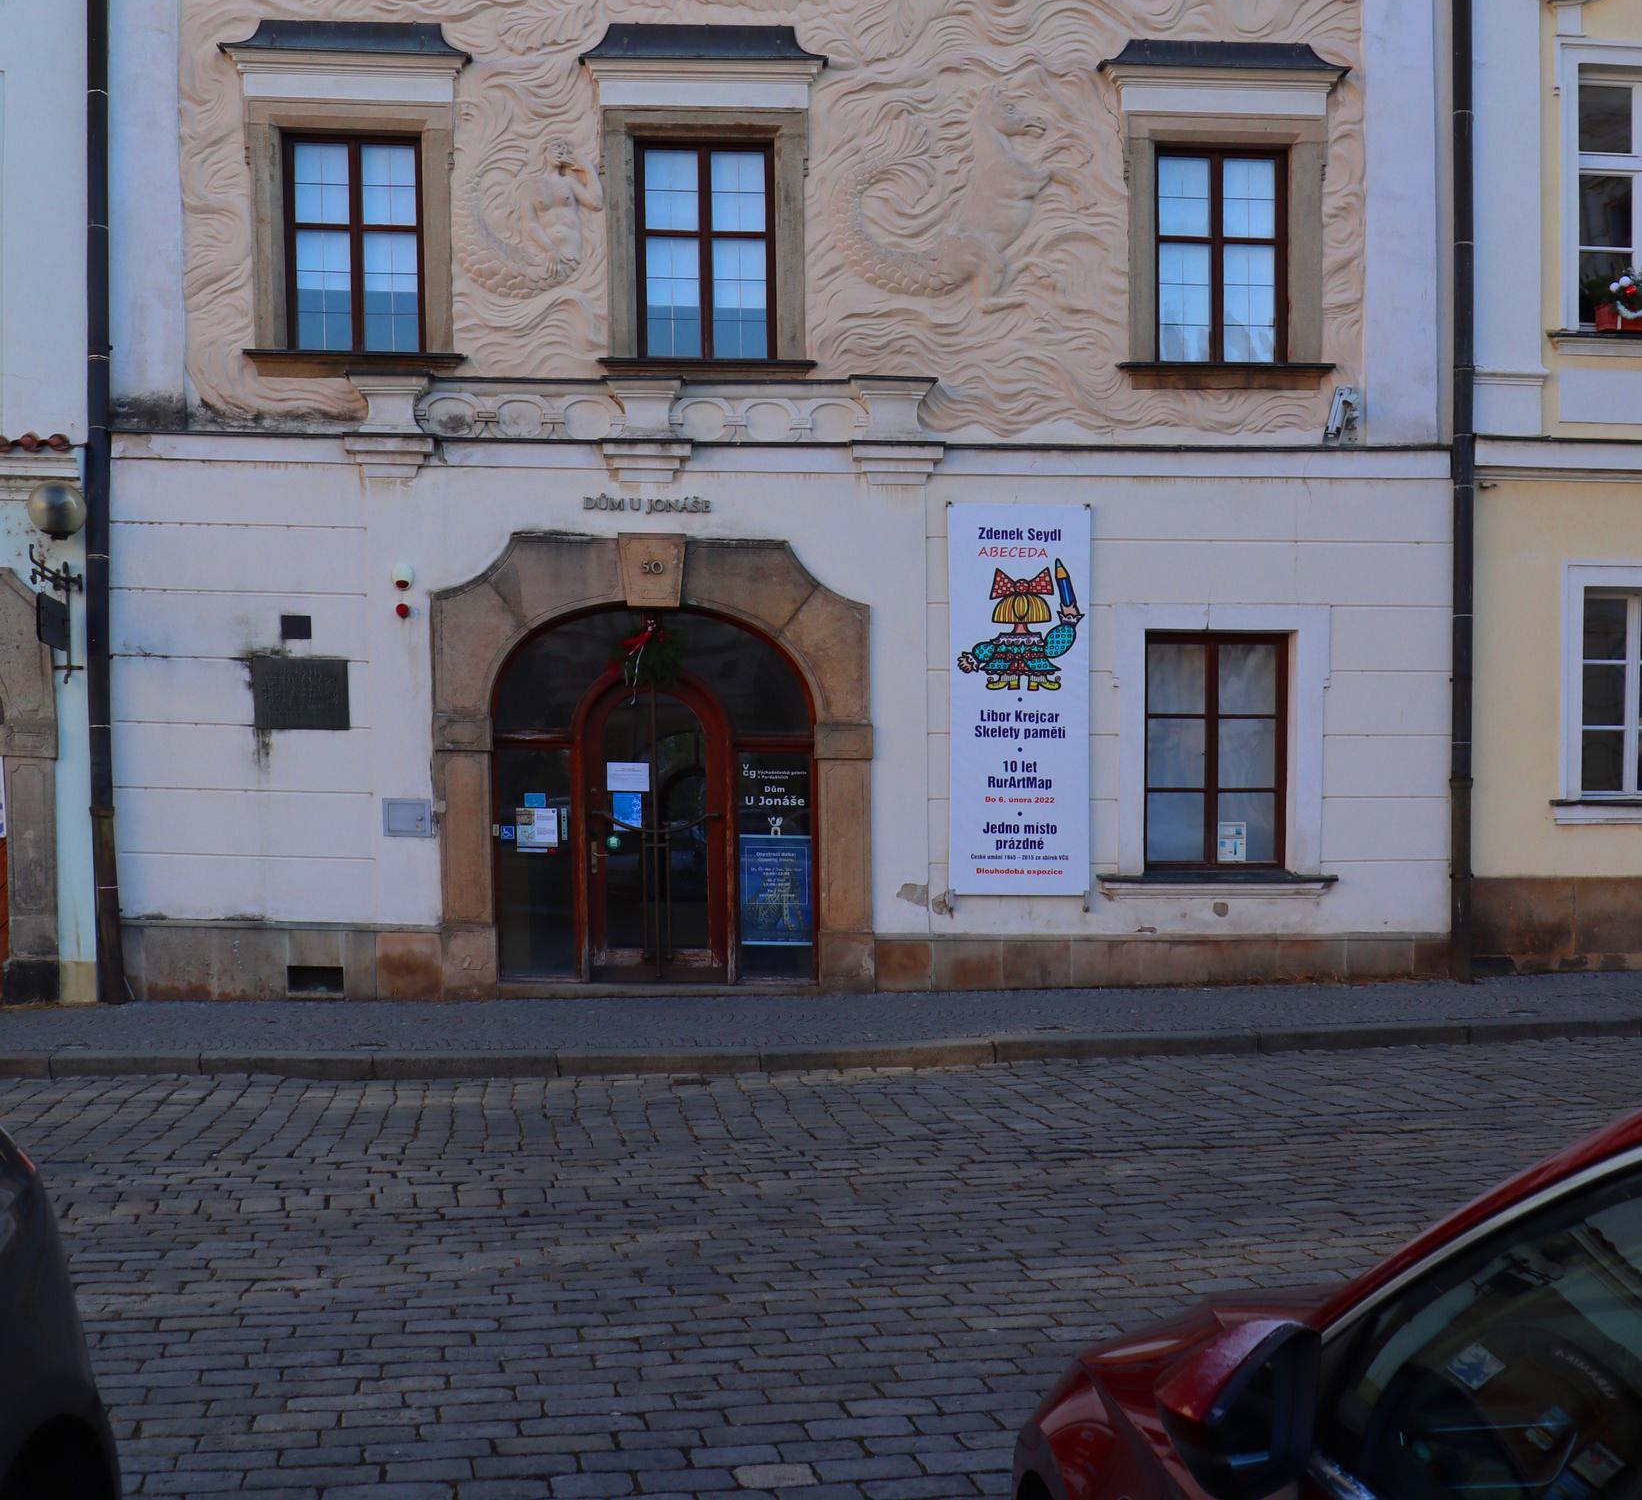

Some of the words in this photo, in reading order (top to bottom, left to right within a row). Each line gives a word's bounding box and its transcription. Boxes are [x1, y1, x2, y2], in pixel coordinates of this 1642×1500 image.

[583, 493, 625, 511] DŮM
[629, 498, 642, 511] U
[645, 496, 712, 515] JONÁŠE
[978, 527, 1024, 540] Zdenek
[1027, 528, 1062, 542] Seydl
[978, 546, 1049, 558] ABECEDA
[641, 561, 664, 575] 50
[980, 709, 1012, 722] Libor
[1015, 710, 1060, 724] Krejcar
[974, 725, 1020, 740] Skelety
[1024, 726, 1066, 740] paměti
[1003, 760, 1018, 773] 10
[1021, 760, 1038, 773] let
[764, 785, 785, 793] Dům
[987, 776, 1053, 790] RurArtMap
[745, 795, 755, 806] U
[758, 795, 806, 806] Jonáše
[1008, 795, 1032, 803] února
[982, 821, 1020, 834] Jedno
[1023, 821, 1058, 835] místo
[995, 836, 1045, 851] prázdné
[976, 867, 1025, 875] Dlouhodobá
[1026, 868, 1064, 877] expozice
